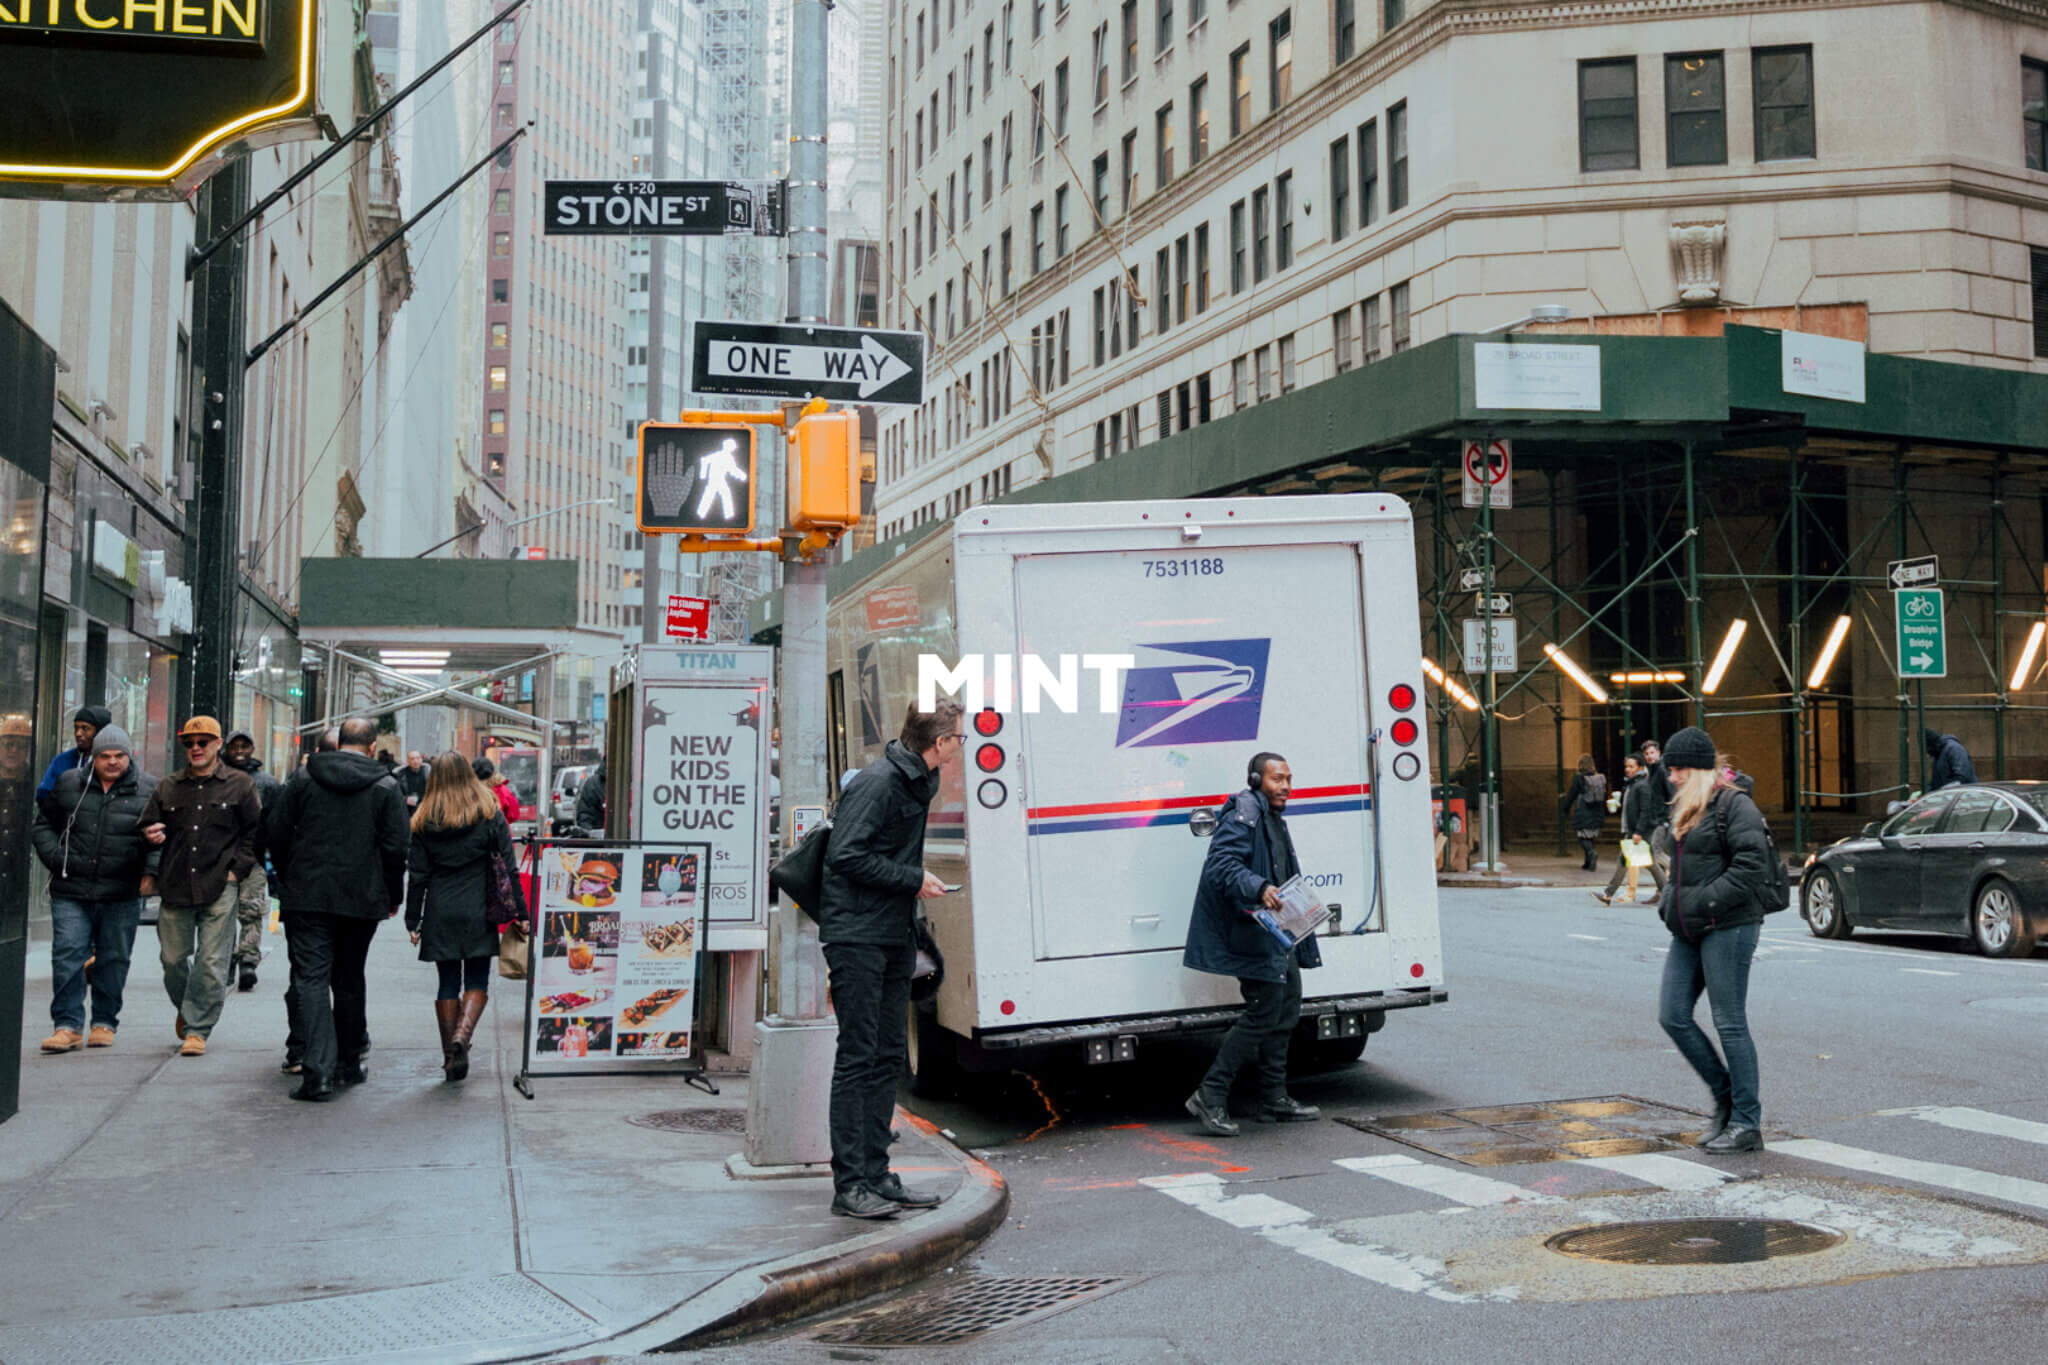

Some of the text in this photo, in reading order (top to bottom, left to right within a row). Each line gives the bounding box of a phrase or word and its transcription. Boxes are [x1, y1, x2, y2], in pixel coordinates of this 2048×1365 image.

[628, 182, 656, 195] 1-20
[557, 196, 710, 225] STONE ST
[727, 345, 889, 381] ONE WAY
[1142, 558, 1225, 578] 7531188
[1903, 624, 1938, 636] Brooklyn
[1909, 638, 1934, 650] Bridge
[677, 653, 736, 669] TITAN
[670, 736, 732, 756] NEW
[671, 760, 730, 781] KIDS
[653, 785, 746, 805] ON THE
[663, 809, 735, 830] GUAC
[715, 850, 730, 861] St
[1303, 872, 1343, 888] com
[704, 886, 747, 900] ROS
